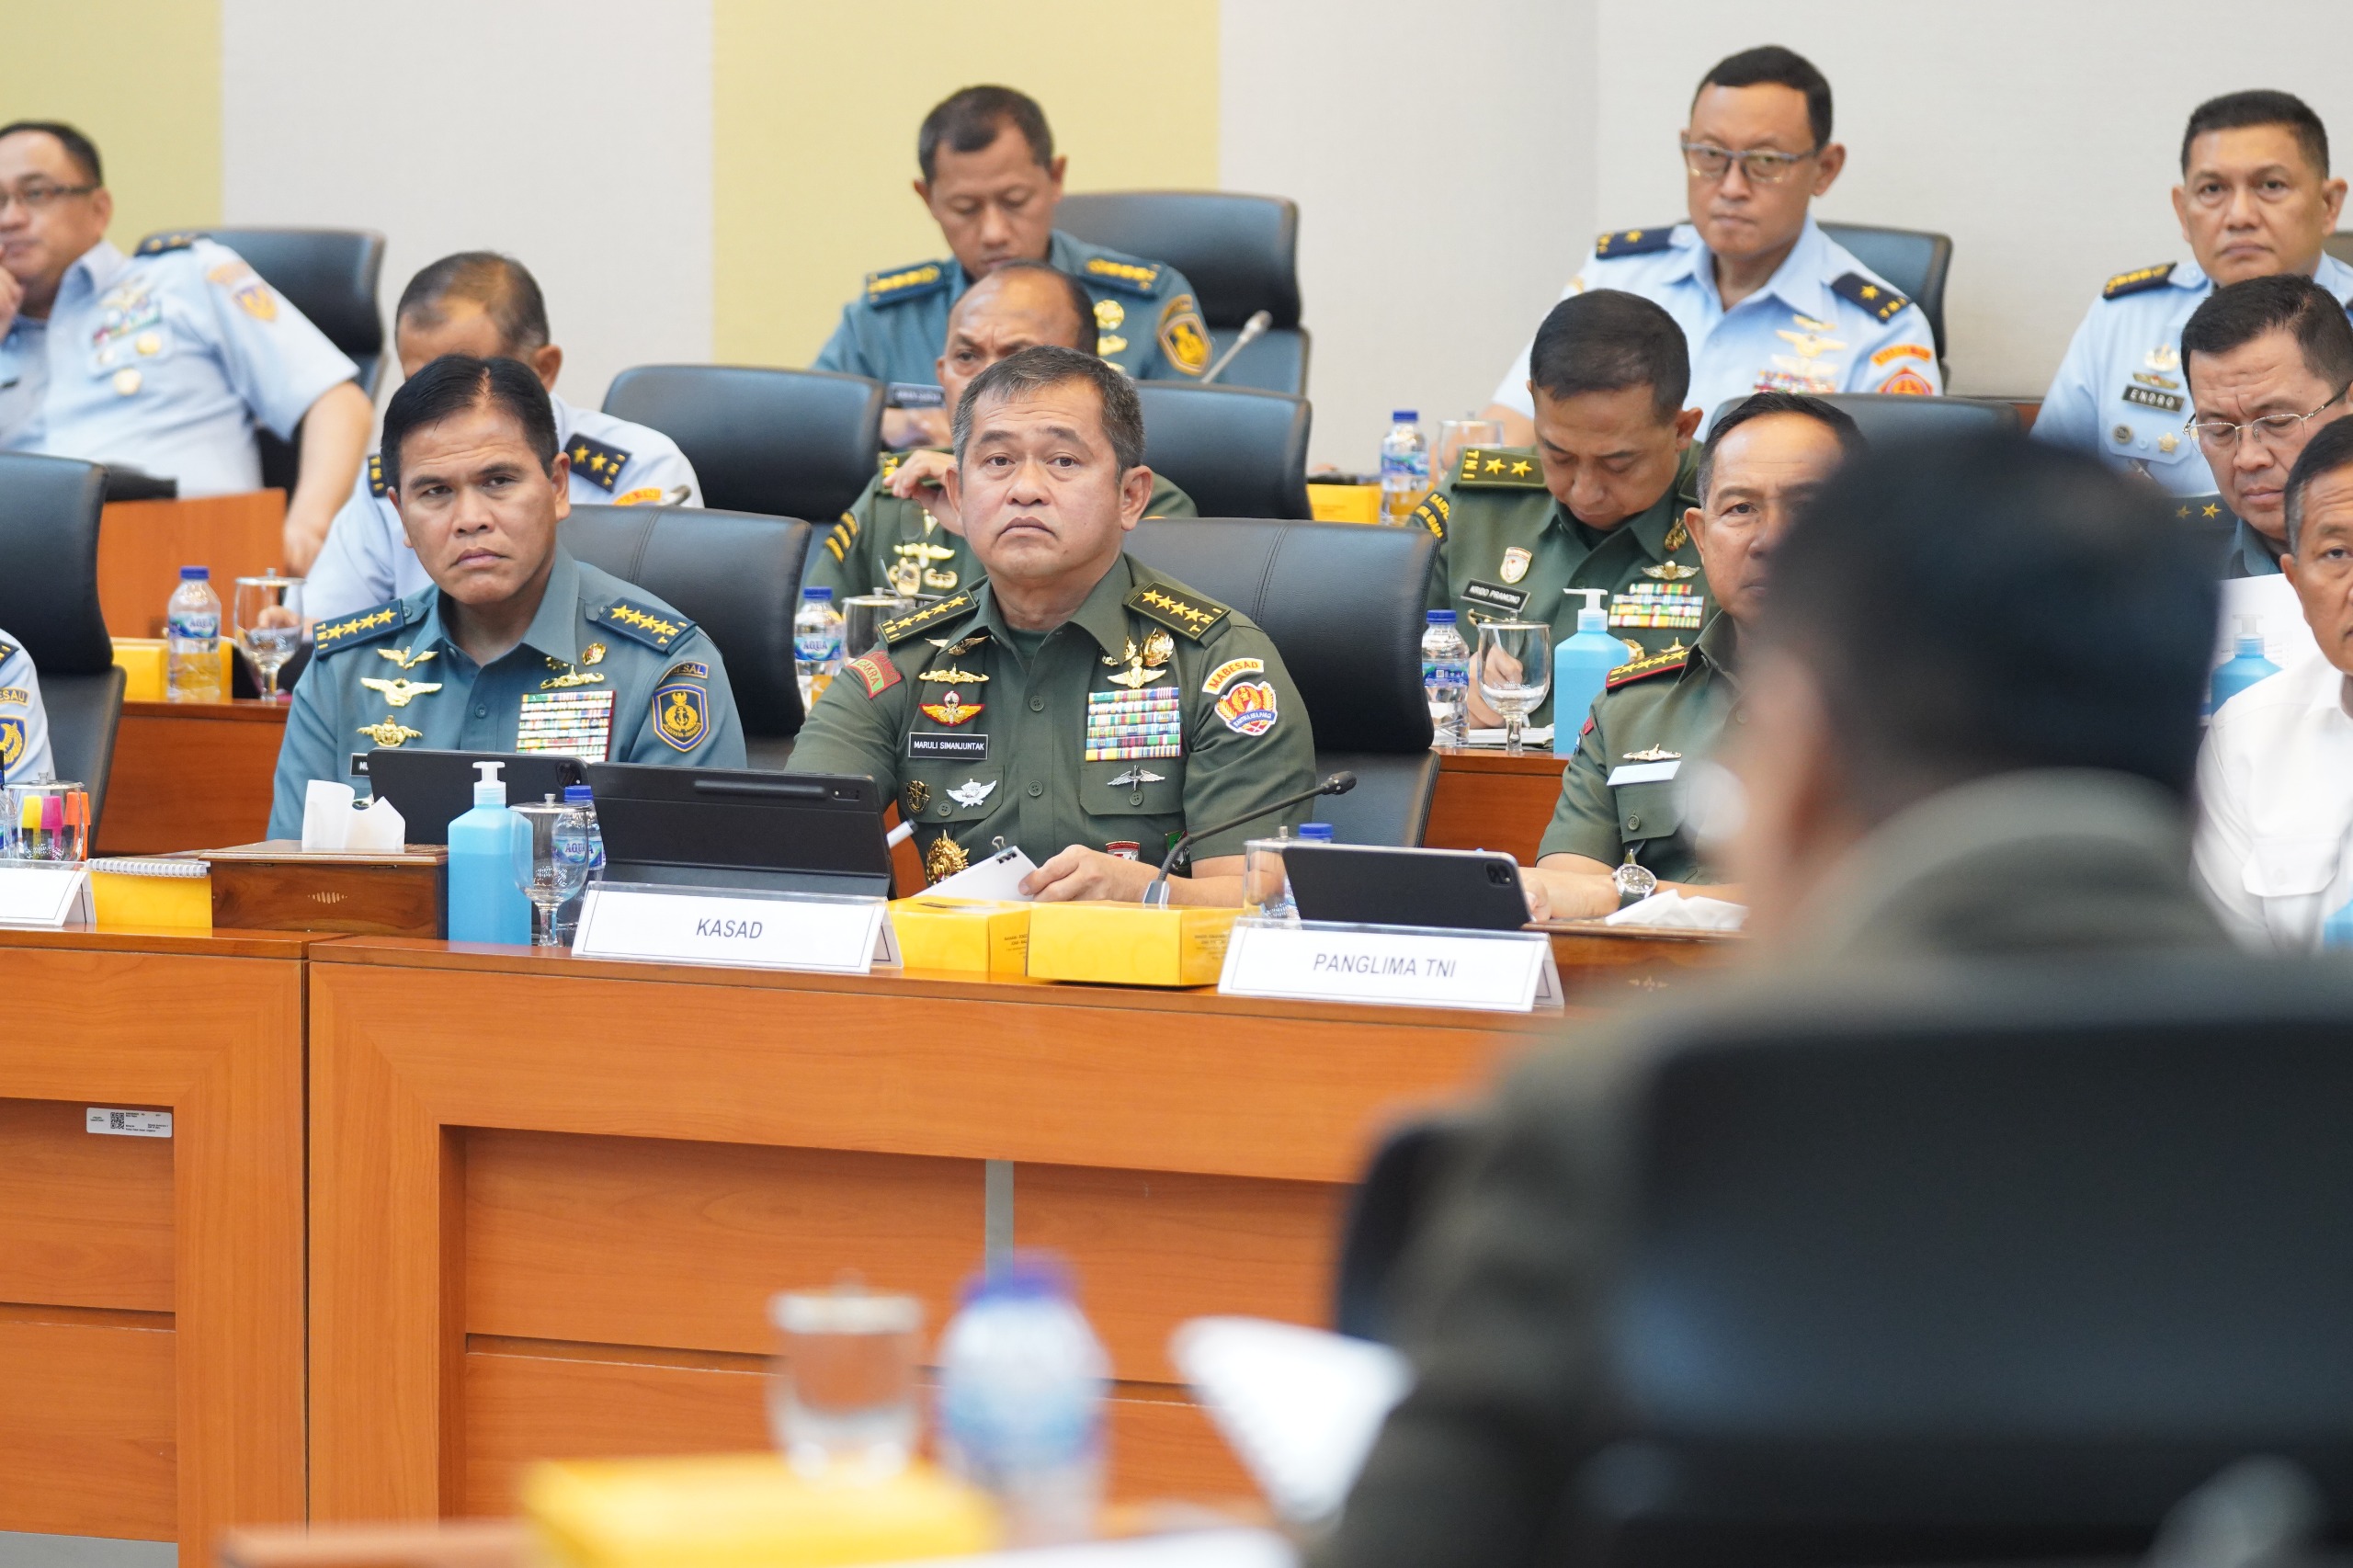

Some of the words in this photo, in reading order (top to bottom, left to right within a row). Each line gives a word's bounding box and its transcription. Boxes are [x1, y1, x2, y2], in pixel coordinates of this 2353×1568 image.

[1188, 608, 1222, 635] TNI
[803, 640, 828, 651] AQUA
[857, 660, 880, 687] CAKRA
[1208, 660, 1258, 688] MABESAD
[0, 689, 25, 701] SAU
[914, 741, 938, 749] MARULI
[939, 742, 984, 751] SIMANJUNTAK
[696, 918, 763, 939] KASAD
[1313, 953, 1416, 976] PANGLIMA
[1426, 959, 1457, 978] TNI
